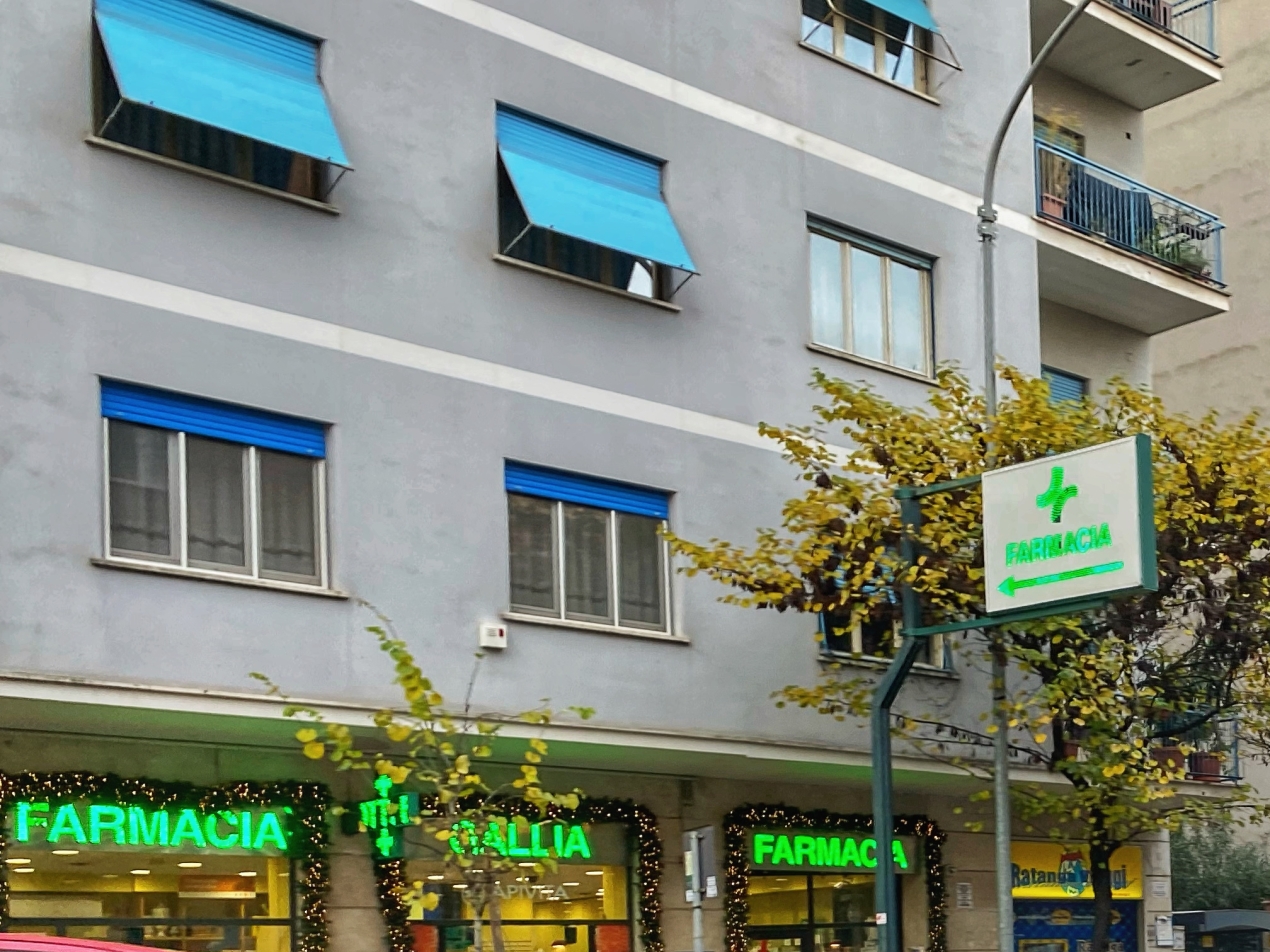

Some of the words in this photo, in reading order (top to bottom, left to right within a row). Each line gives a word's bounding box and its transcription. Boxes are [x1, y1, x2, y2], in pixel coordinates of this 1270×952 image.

[1006, 523, 1112, 567] FARMACIA
[14, 801, 288, 850] FARMACIA
[754, 834, 908, 868] FARMACA
